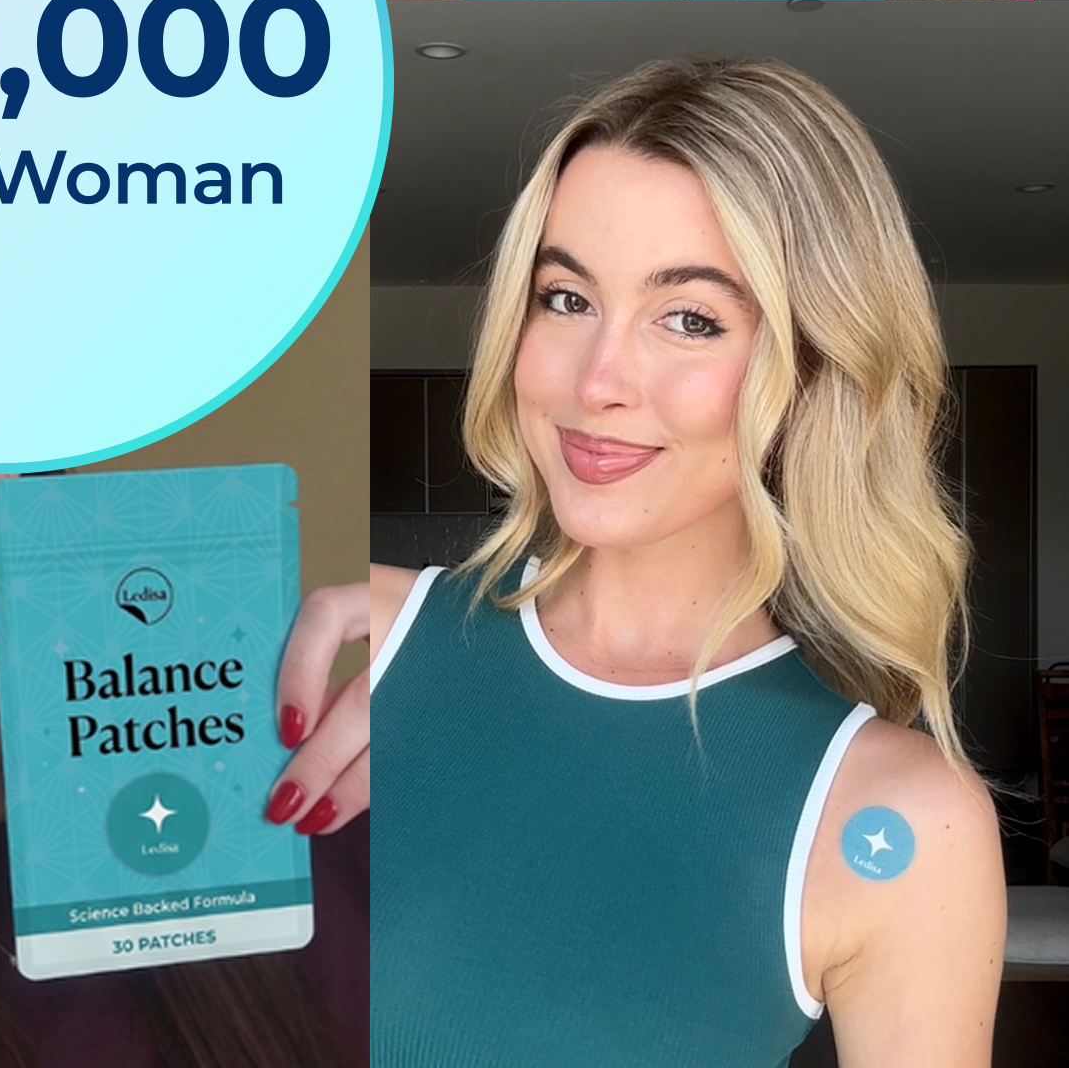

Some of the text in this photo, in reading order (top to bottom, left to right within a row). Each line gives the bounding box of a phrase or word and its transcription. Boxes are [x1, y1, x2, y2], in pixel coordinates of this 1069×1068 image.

[121, 586, 168, 603] Ledisa
[63, 652, 244, 703] Balance
[67, 704, 246, 758] Patches
[69, 889, 257, 924] Science Backed Formula
[111, 929, 217, 955] 30 PATCHES
